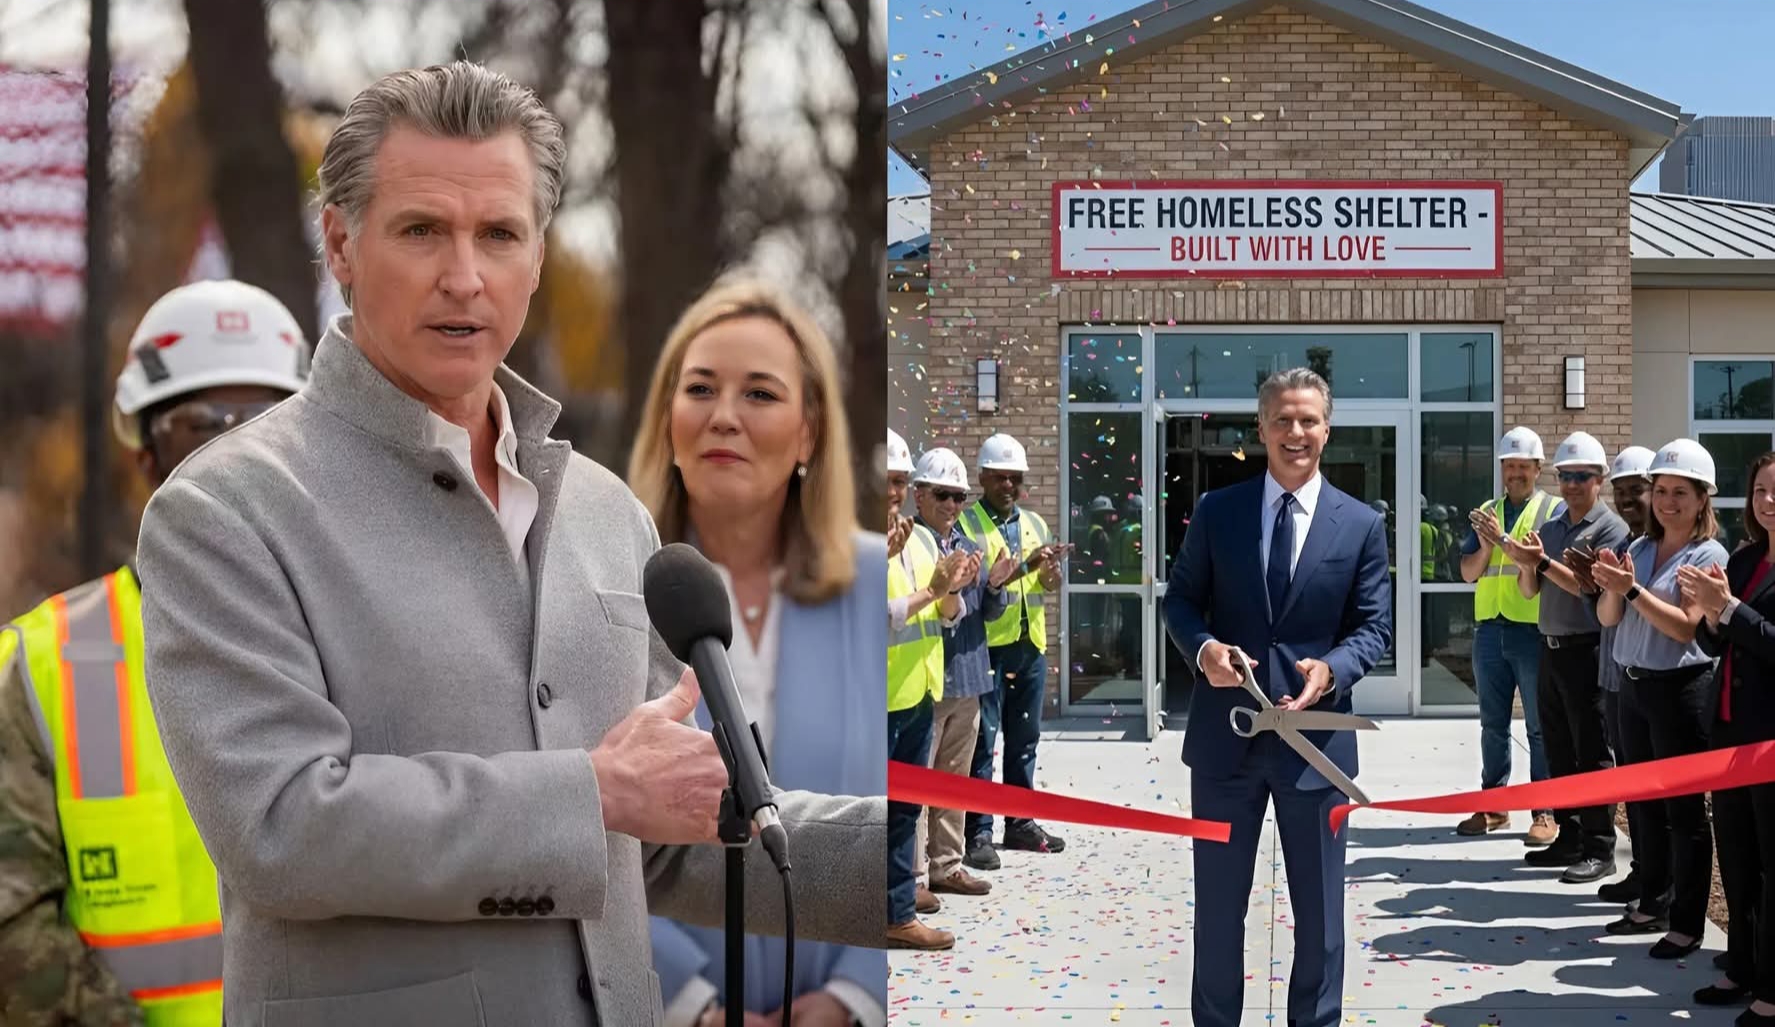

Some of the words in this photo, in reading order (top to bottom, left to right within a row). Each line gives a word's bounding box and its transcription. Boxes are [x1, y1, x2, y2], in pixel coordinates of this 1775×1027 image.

[1068, 197, 1145, 228] FREE
[1157, 196, 1323, 229] HOMELESS
[1333, 196, 1468, 229] SHELTER
[1170, 236, 1241, 262] BUILT
[1248, 236, 1313, 262] WITH
[1322, 235, 1386, 262] LOVE
